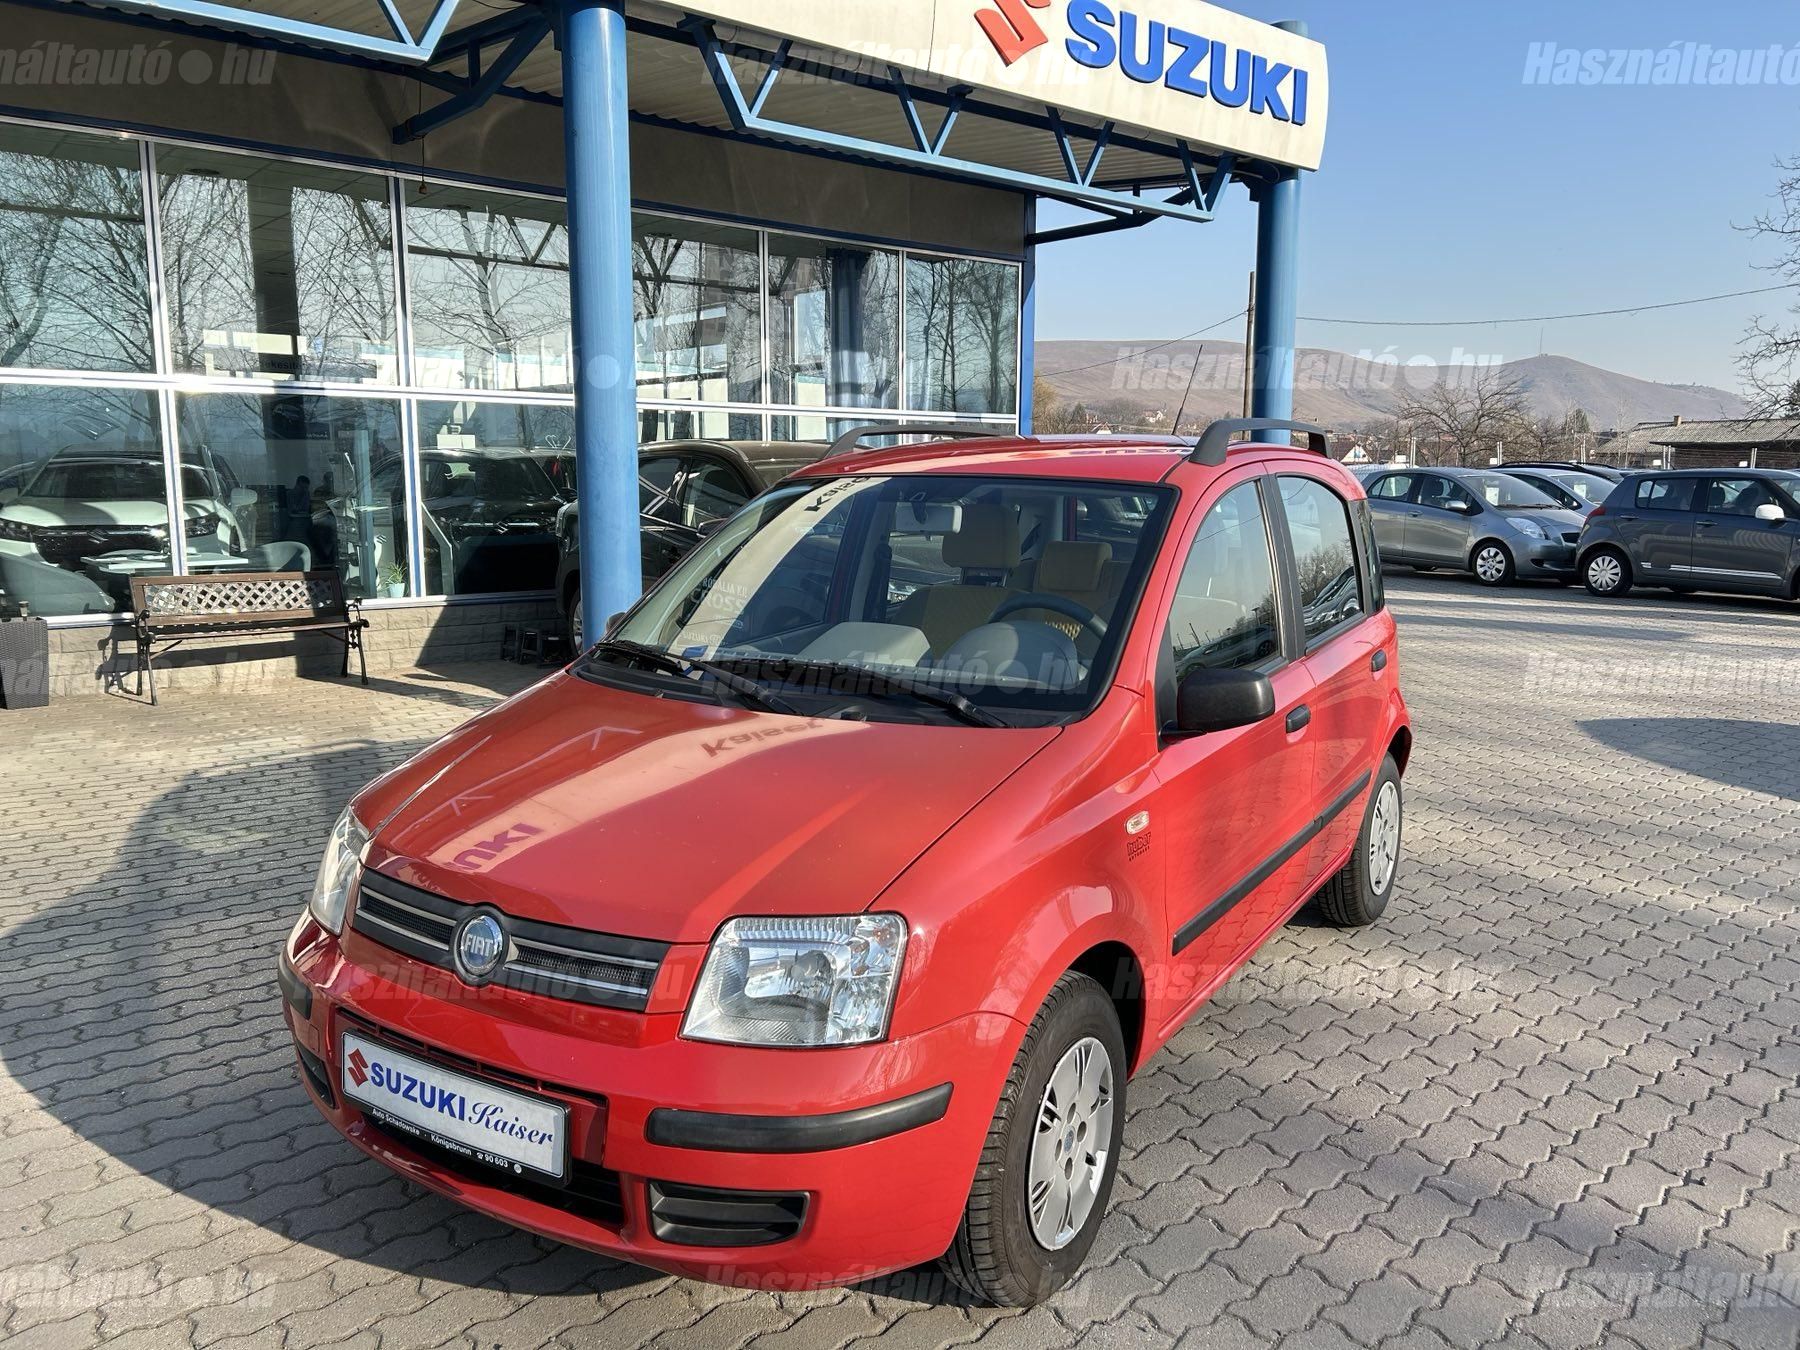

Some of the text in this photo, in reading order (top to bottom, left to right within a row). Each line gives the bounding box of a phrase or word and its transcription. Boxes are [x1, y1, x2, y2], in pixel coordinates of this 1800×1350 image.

[1066, 0, 1308, 126] SUZUKI
[464, 933, 494, 957] FIAT
[370, 1061, 554, 1146] SUZUKI Kaiser
[371, 1107, 385, 1120] Auto
[431, 1133, 473, 1157] Königsbrunn
[484, 1153, 494, 1163] 90
